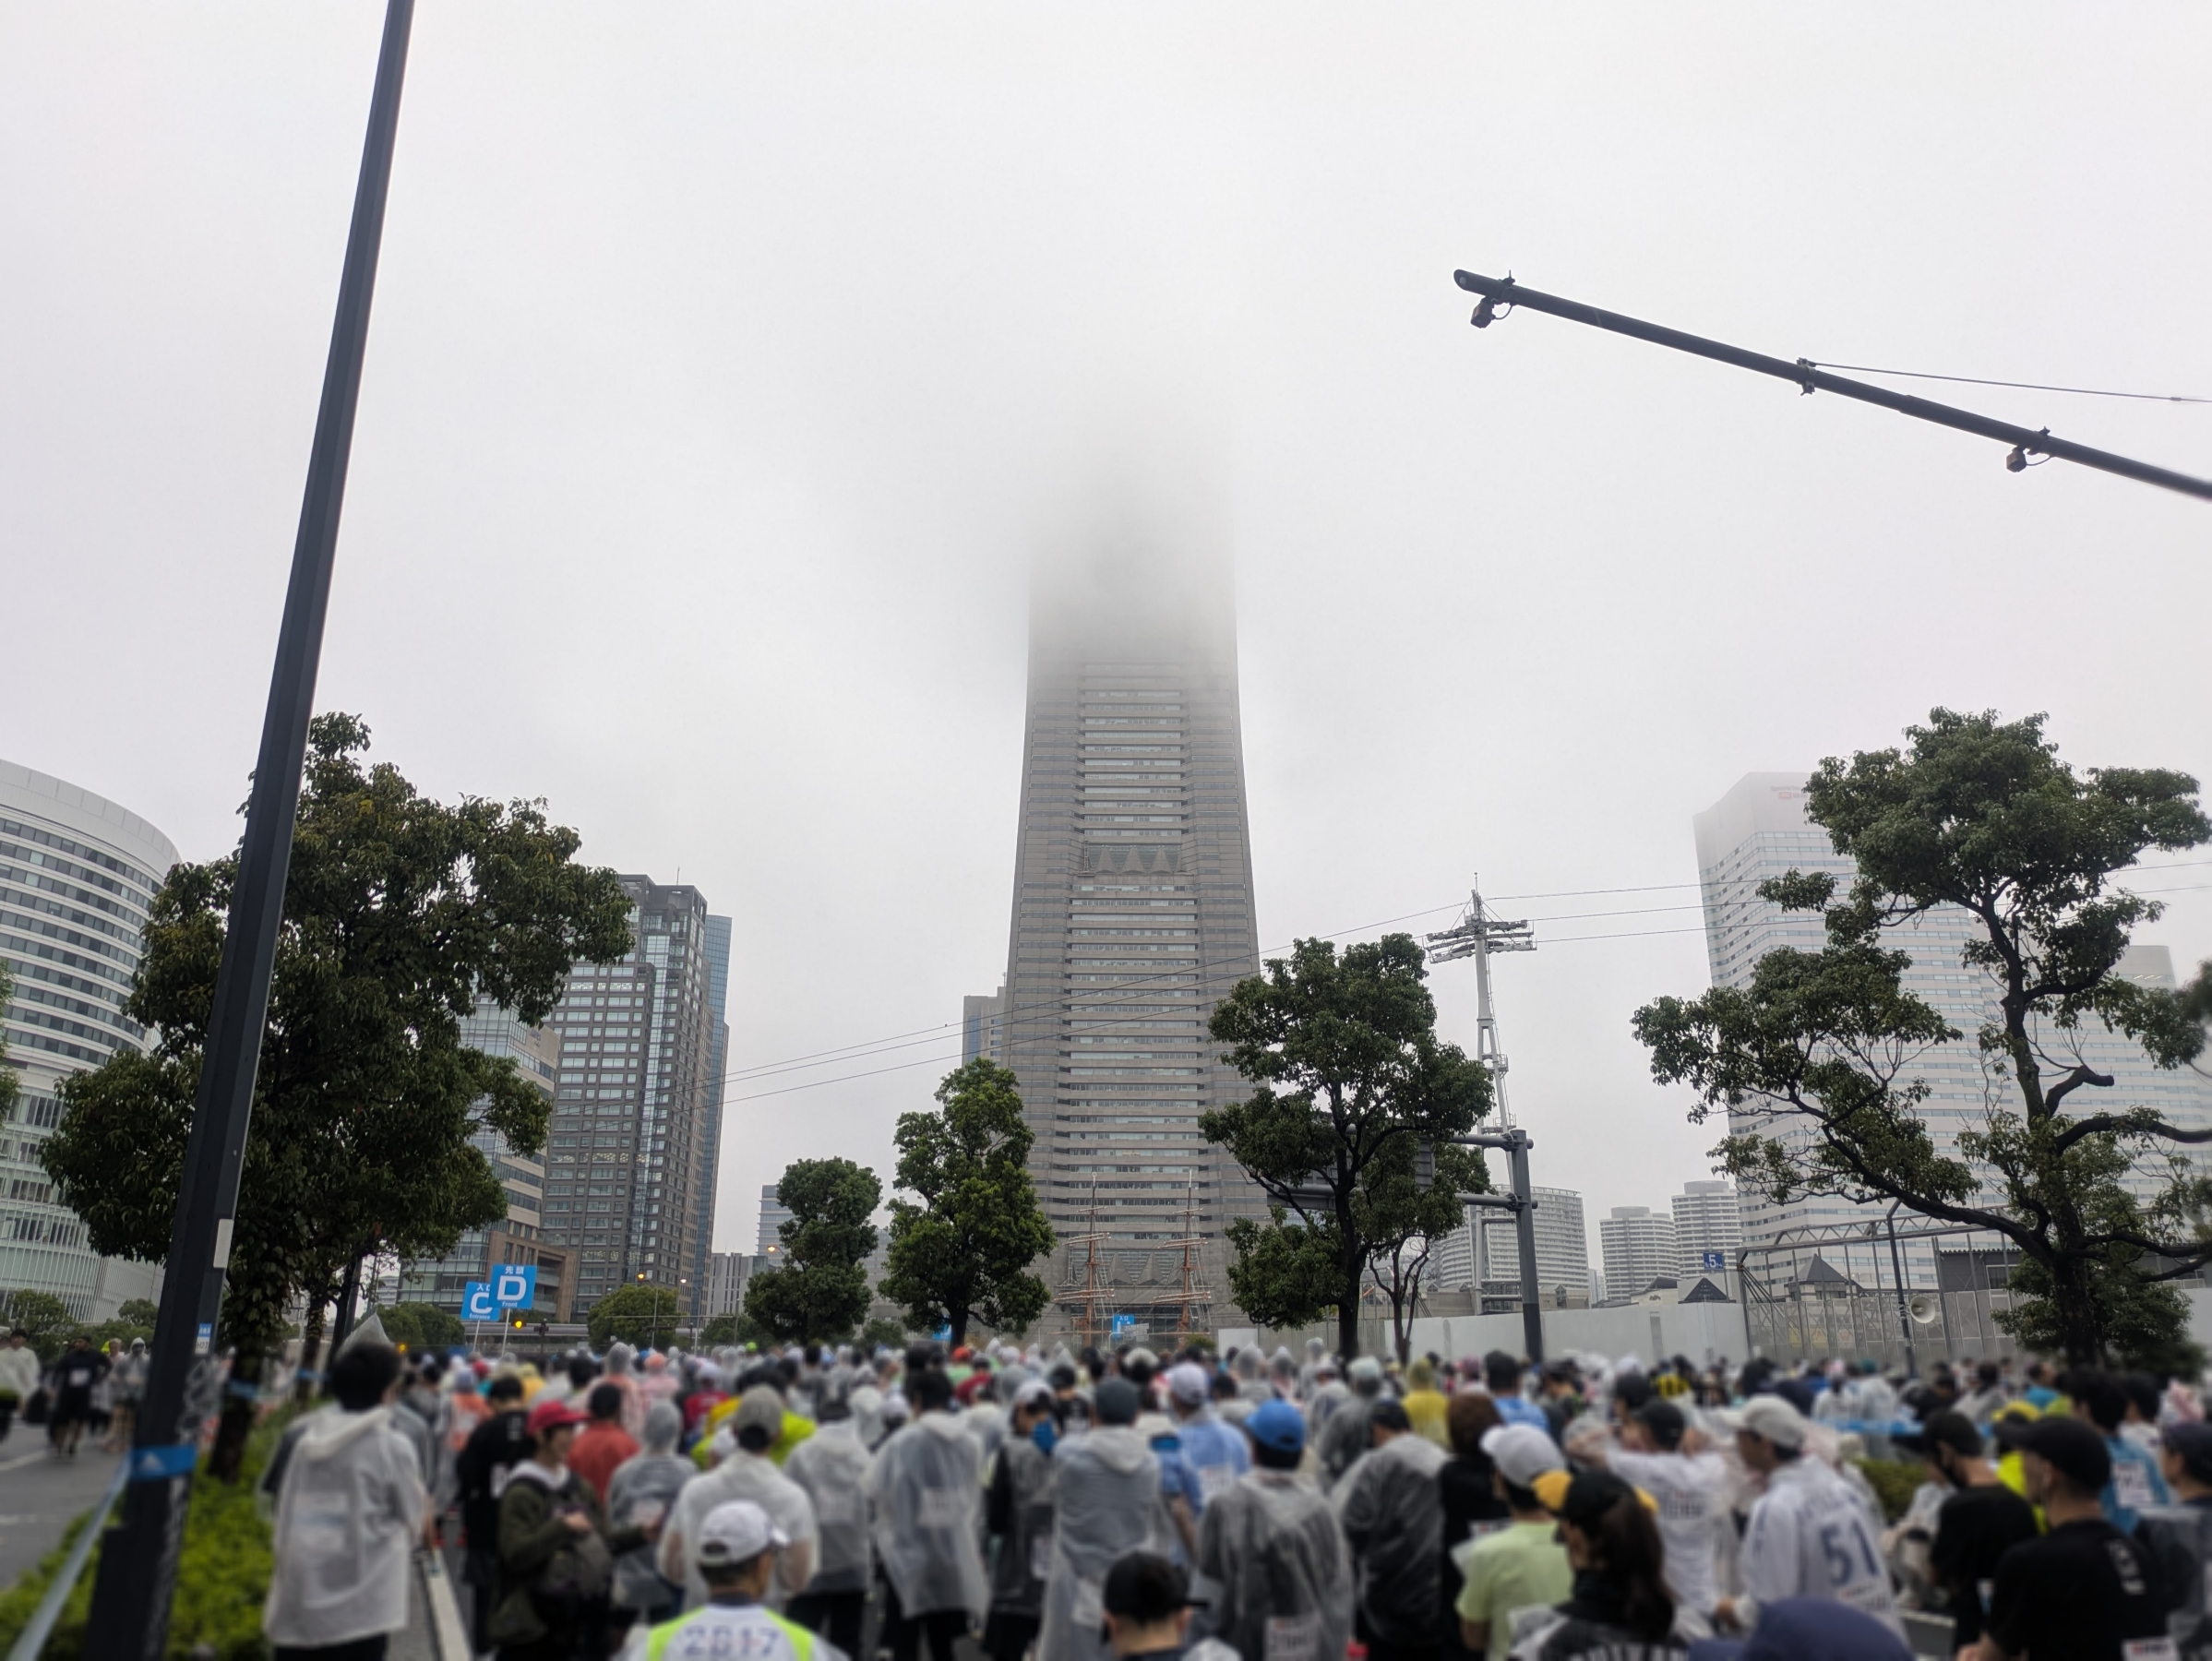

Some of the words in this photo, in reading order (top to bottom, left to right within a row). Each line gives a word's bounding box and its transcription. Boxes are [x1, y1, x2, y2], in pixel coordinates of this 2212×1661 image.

[505, 1265, 525, 1274] 先頭
[1708, 1254, 1716, 1268] 5
[497, 1275, 527, 1300] D
[471, 1292, 493, 1314] C
[1821, 1519, 1879, 1585] 51
[684, 1625, 779, 1657] 2017
